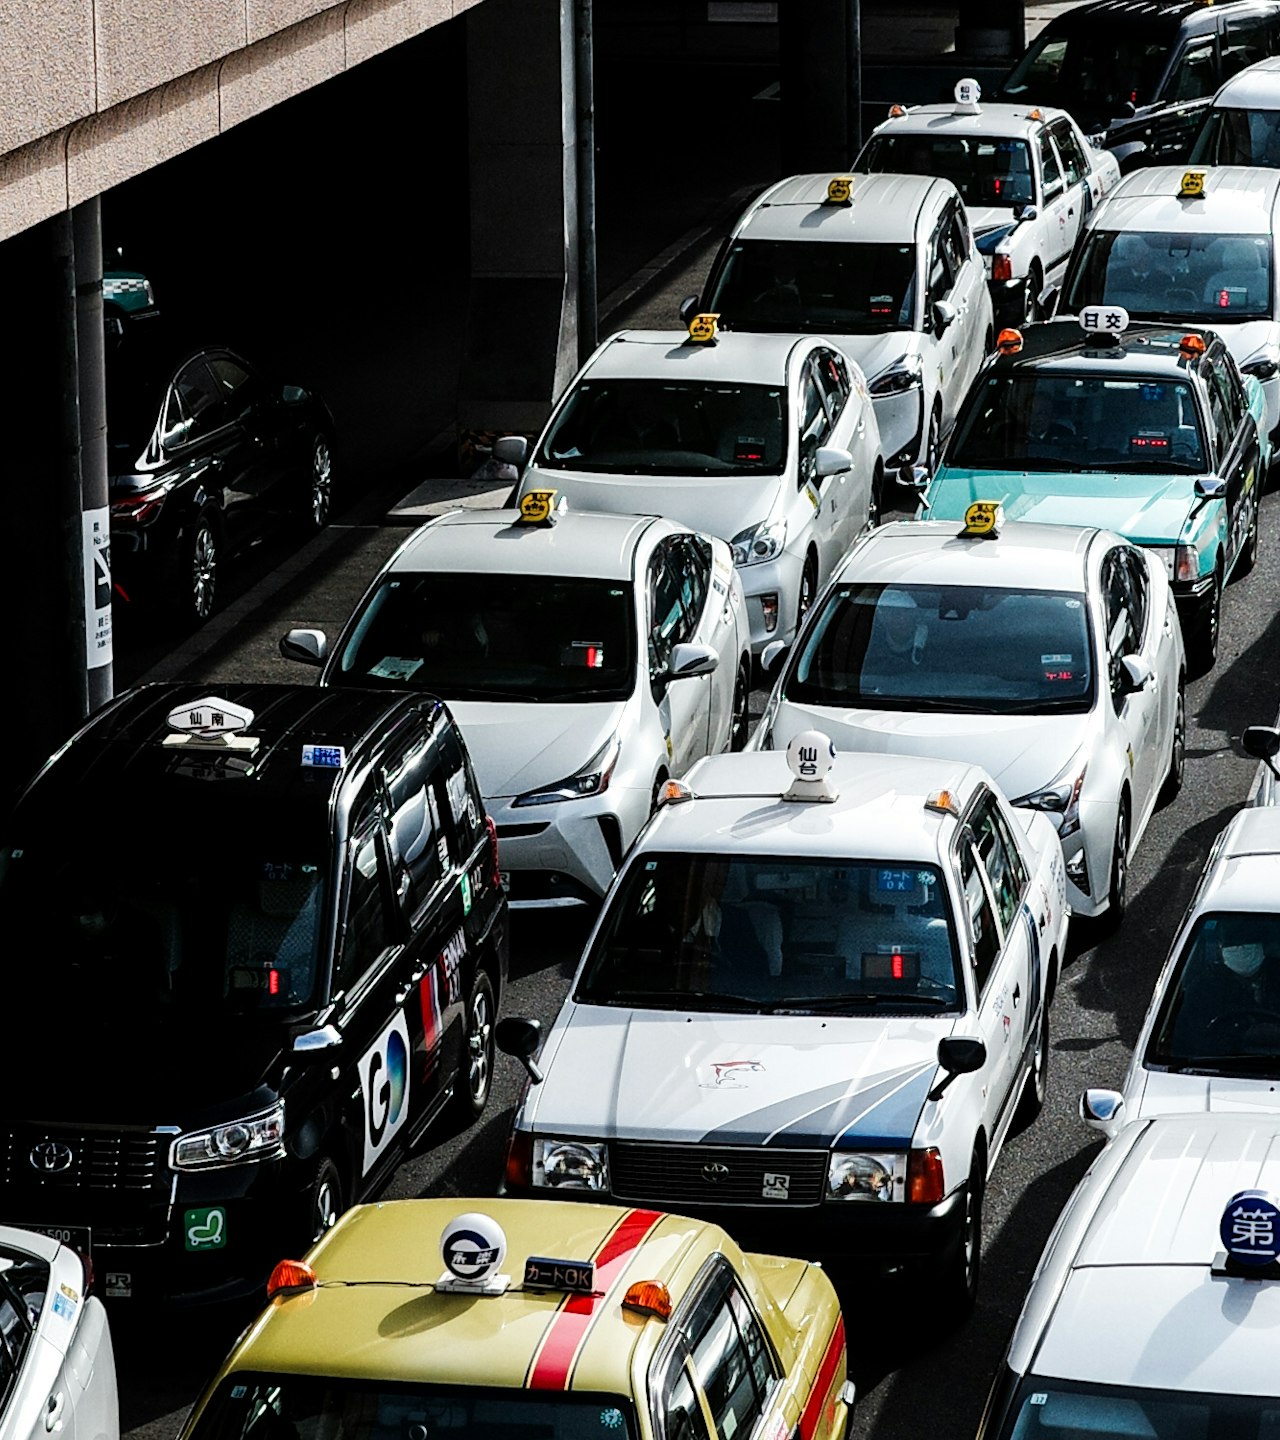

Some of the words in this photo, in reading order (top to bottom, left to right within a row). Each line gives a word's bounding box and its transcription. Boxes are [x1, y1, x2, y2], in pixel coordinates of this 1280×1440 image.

[1085, 312, 1121, 329] 日交
[189, 710, 227, 727] 仙南
[797, 746, 819, 776] 仙台
[263, 861, 293, 871] カード
[882, 871, 910, 881] カード
[886, 881, 906, 890] OK
[527, 1263, 592, 1287] カードOK
